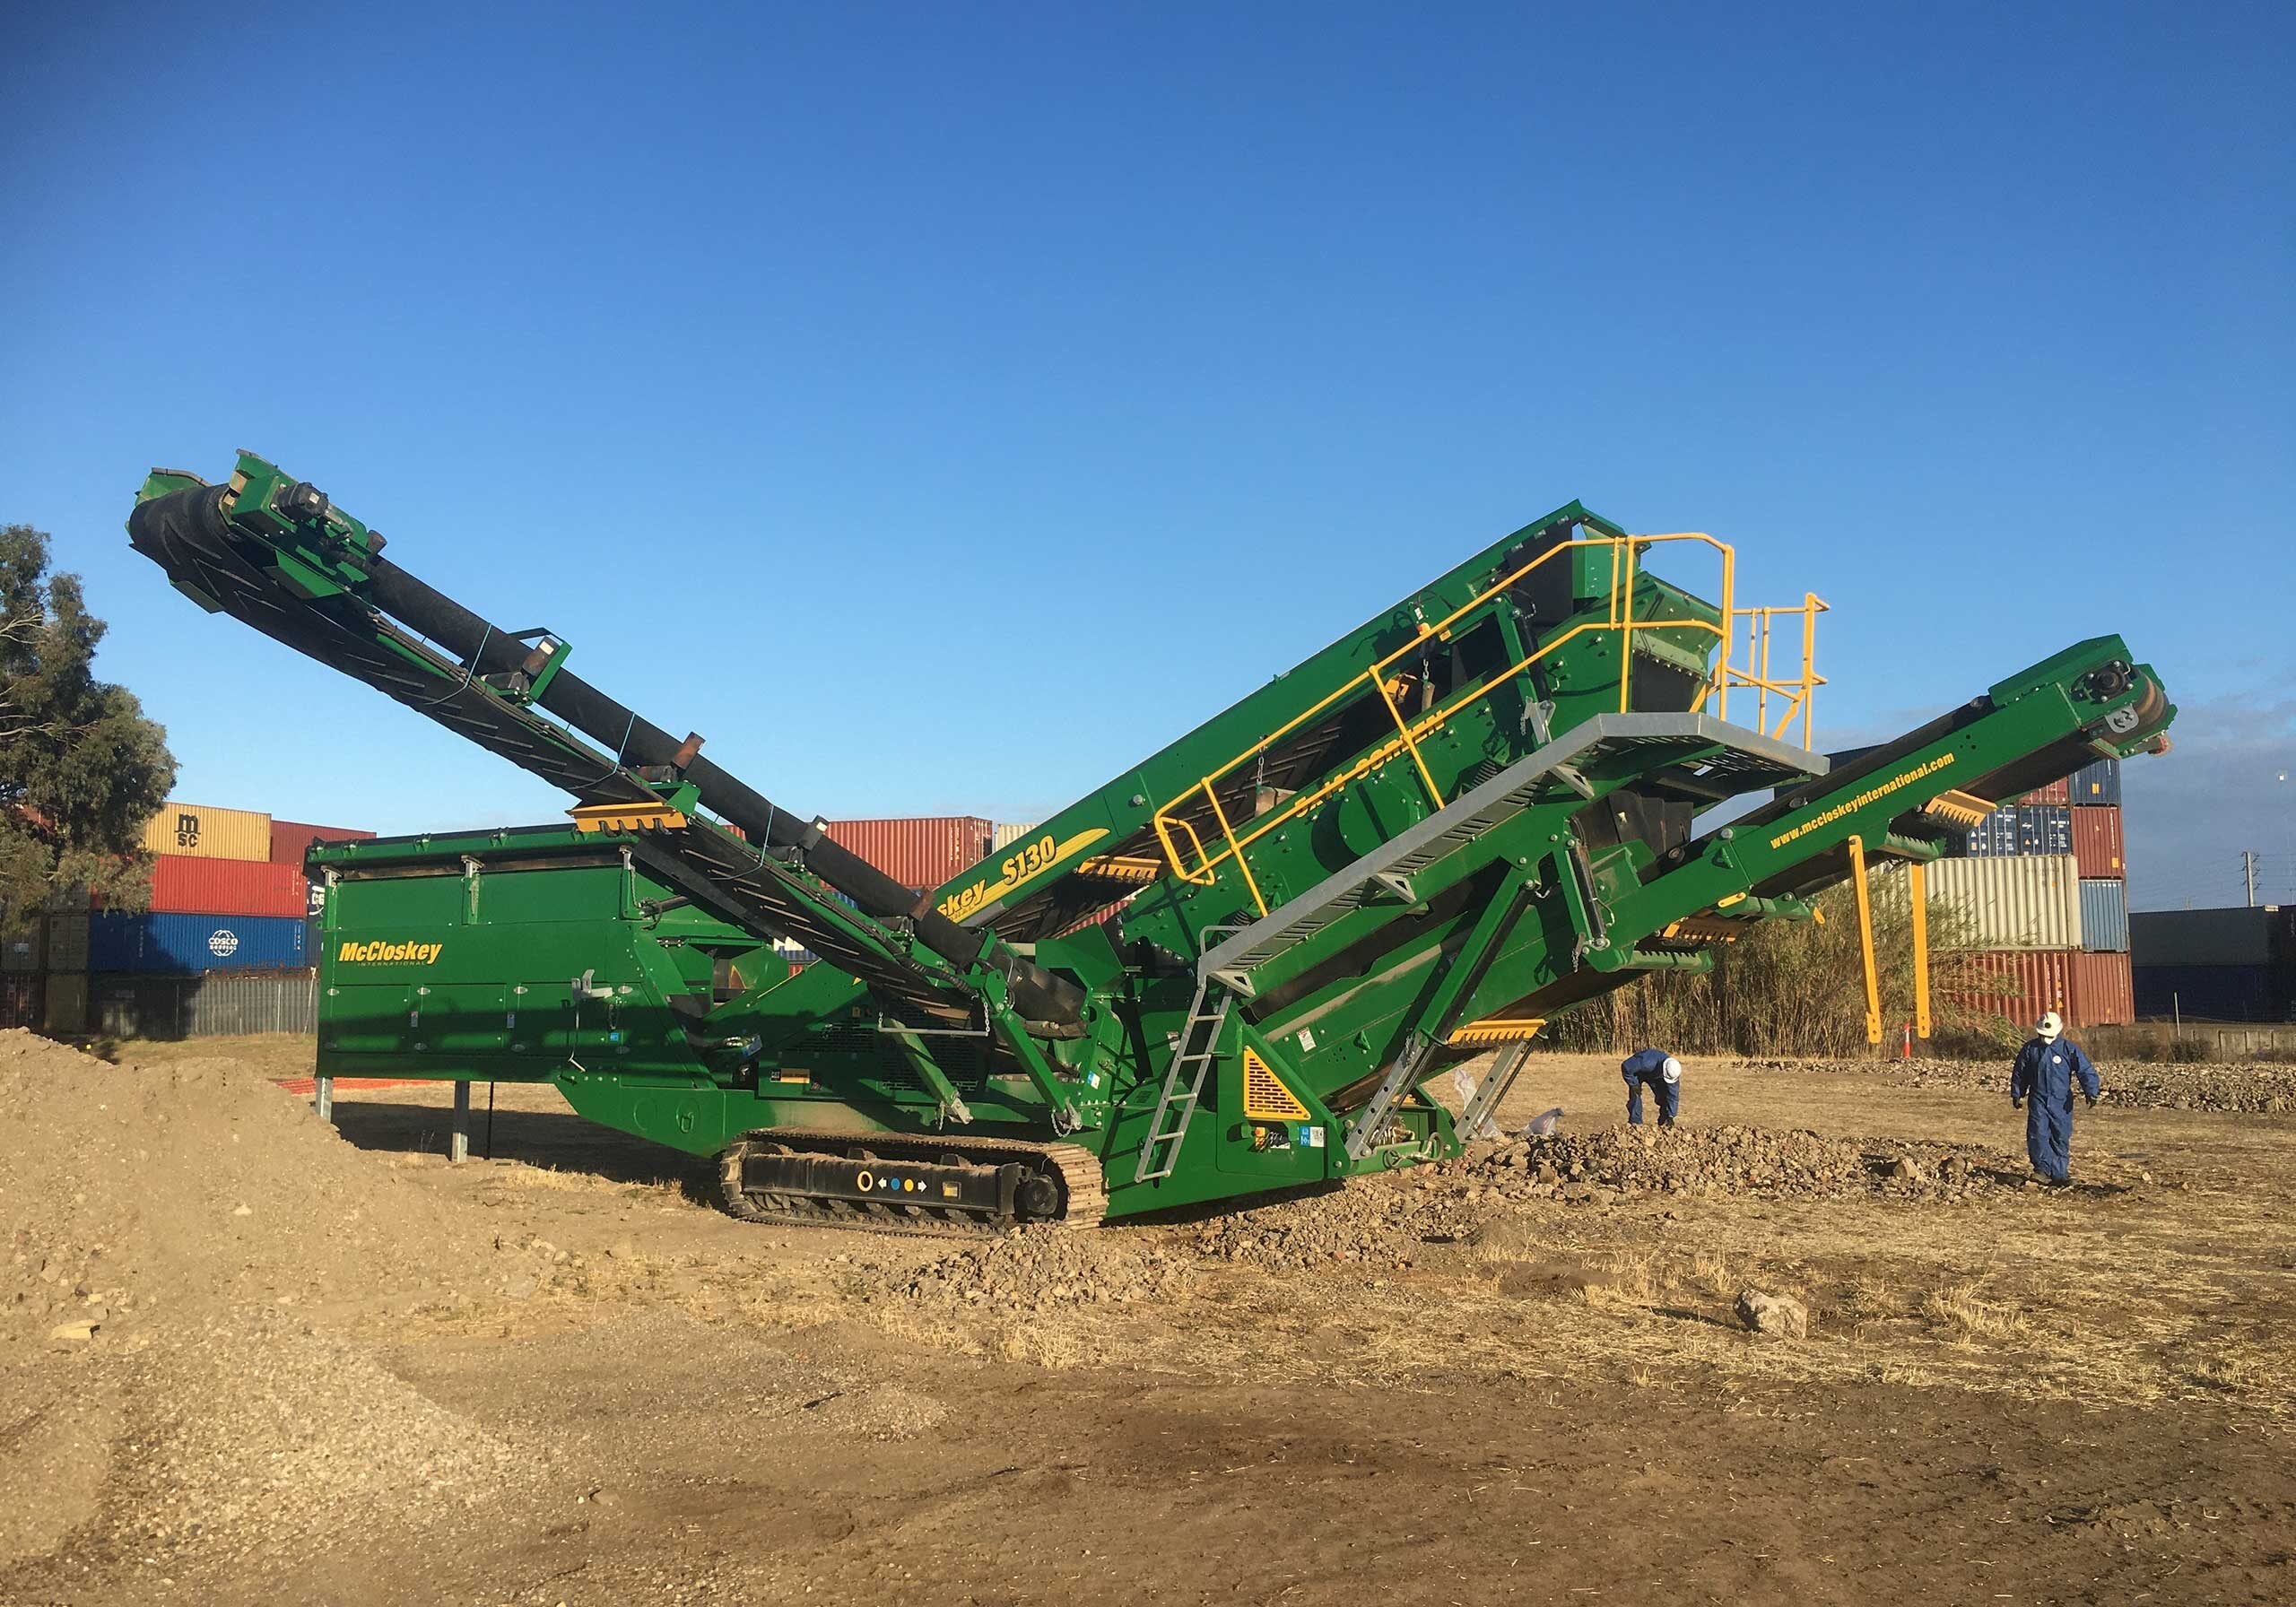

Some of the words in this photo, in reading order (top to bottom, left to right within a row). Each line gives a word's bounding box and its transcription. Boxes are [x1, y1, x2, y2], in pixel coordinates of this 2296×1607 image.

[1770, 753, 1954, 849] www.mccloskeyinternational.com
[1002, 835, 1057, 885] S130
[208, 937, 239, 945] COSCO
[339, 941, 443, 965] McCloskey
